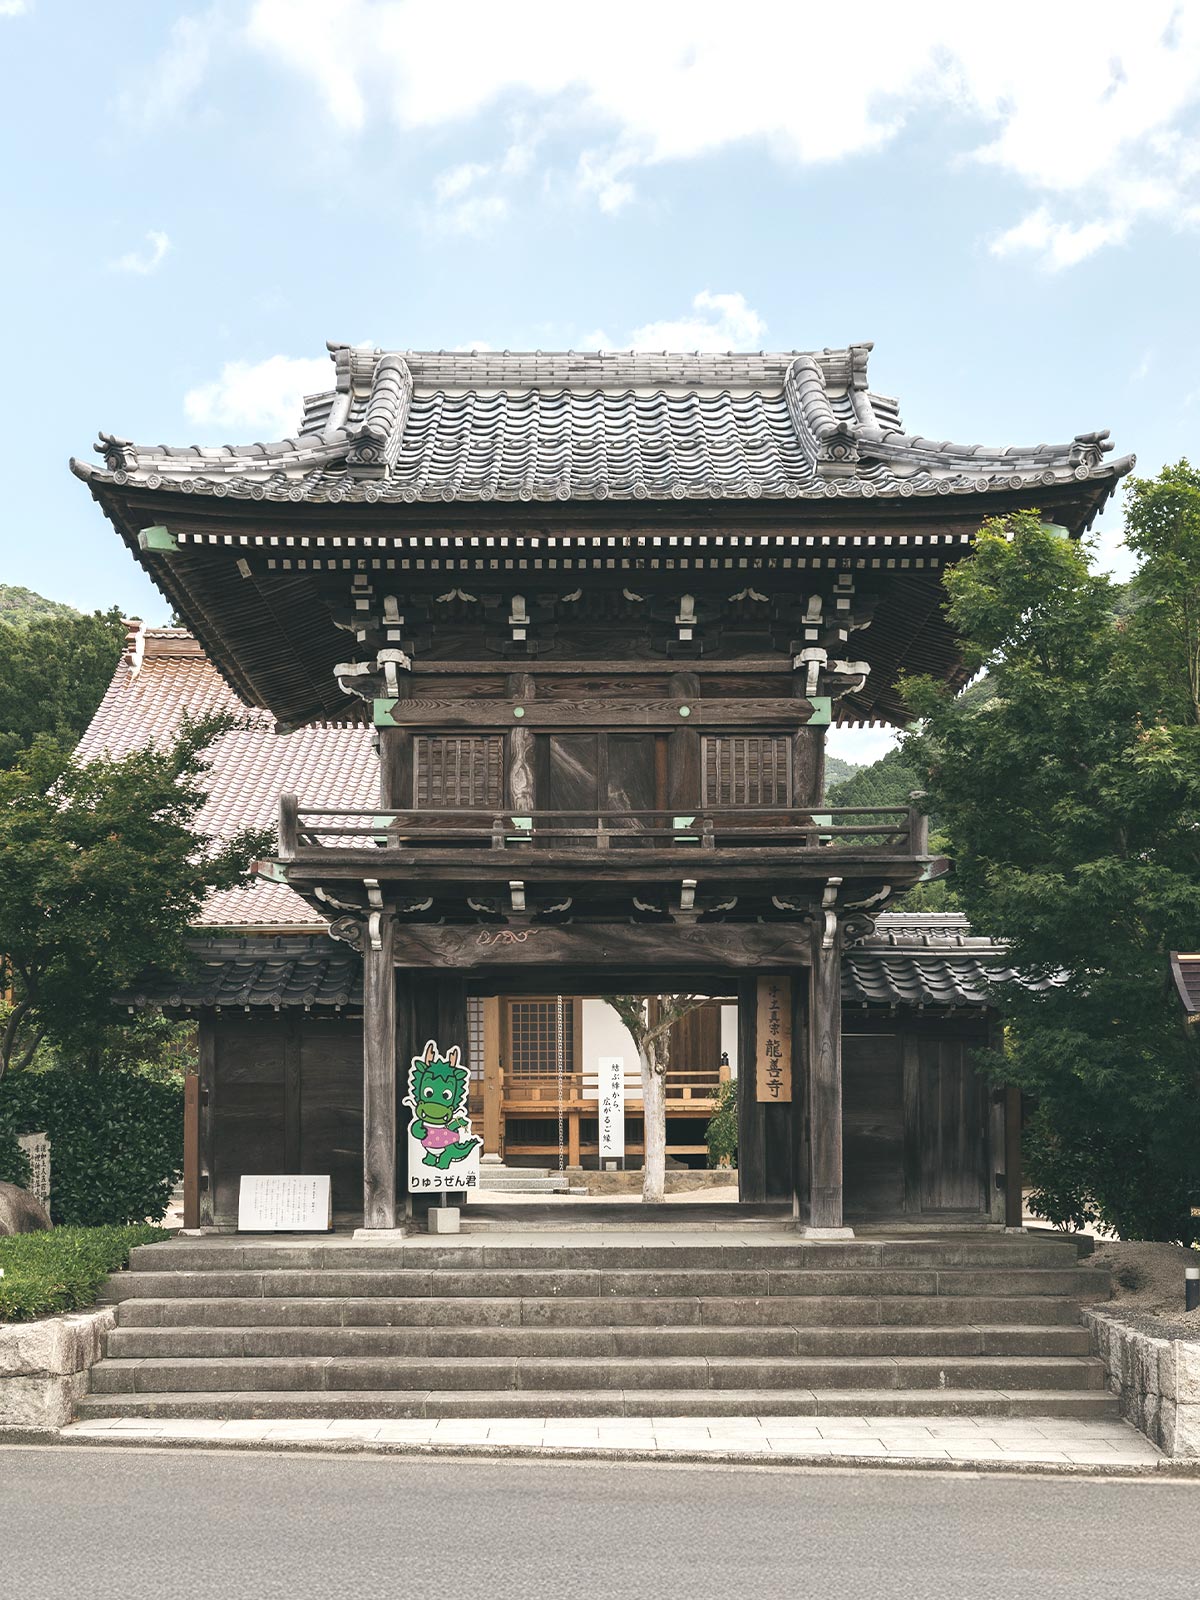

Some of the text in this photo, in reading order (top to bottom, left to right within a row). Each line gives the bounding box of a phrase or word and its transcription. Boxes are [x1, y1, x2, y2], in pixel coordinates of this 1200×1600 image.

[765, 1039, 784, 1098] 龍善寺
[602, 1096, 612, 1150] 広がるご縁へ
[411, 1174, 477, 1188] りゅうぜん君
